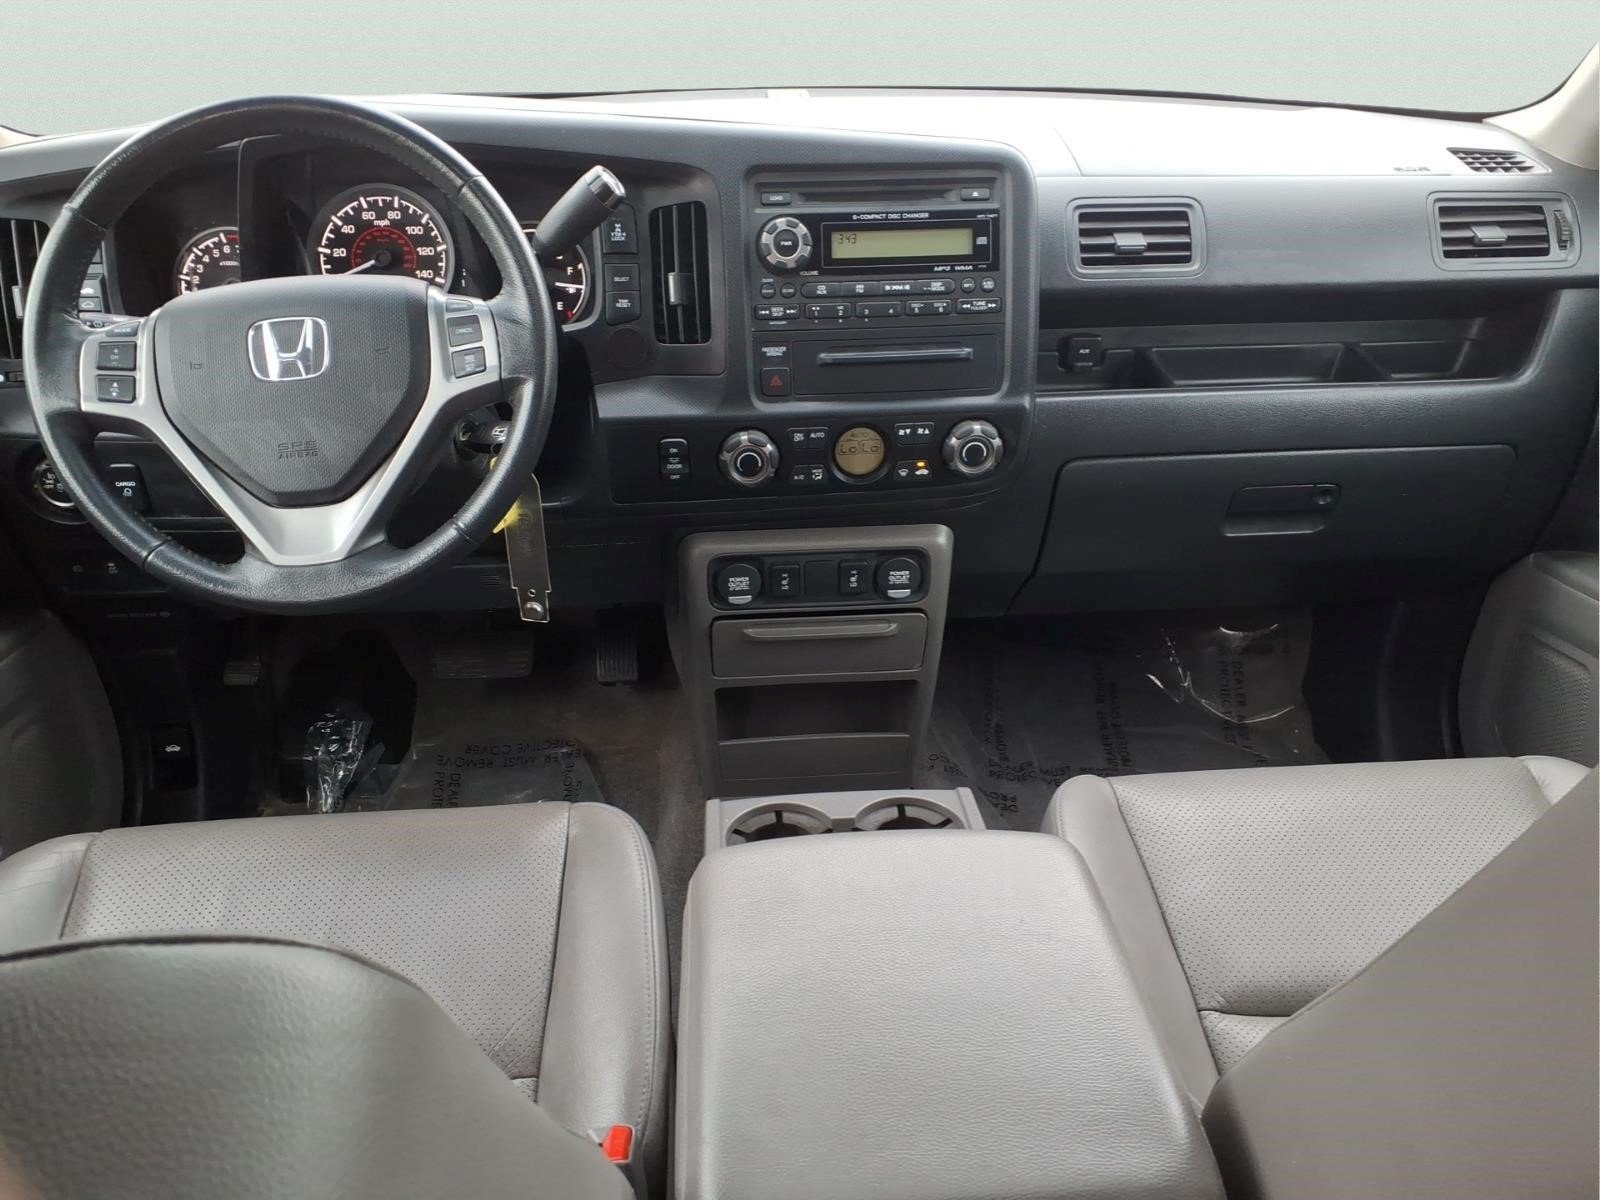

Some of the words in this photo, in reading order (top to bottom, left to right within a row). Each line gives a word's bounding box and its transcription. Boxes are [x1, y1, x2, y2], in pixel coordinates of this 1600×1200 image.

[361, 211, 376, 220] 60
[387, 210, 402, 220] 80
[373, 219, 391, 227] mph
[340, 225, 355, 234] 40
[405, 226, 424, 235] 100
[838, 233, 857, 245] 343
[212, 249, 220, 258] 5
[223, 245, 231, 254] 6
[332, 248, 347, 257] 20
[416, 247, 435, 256] 120
[202, 254, 210, 263] 4
[196, 264, 204, 273] 3
[566, 266, 574, 276] F
[414, 269, 434, 279] 140
[192, 275, 200, 284] 2
[556, 301, 564, 311] E
